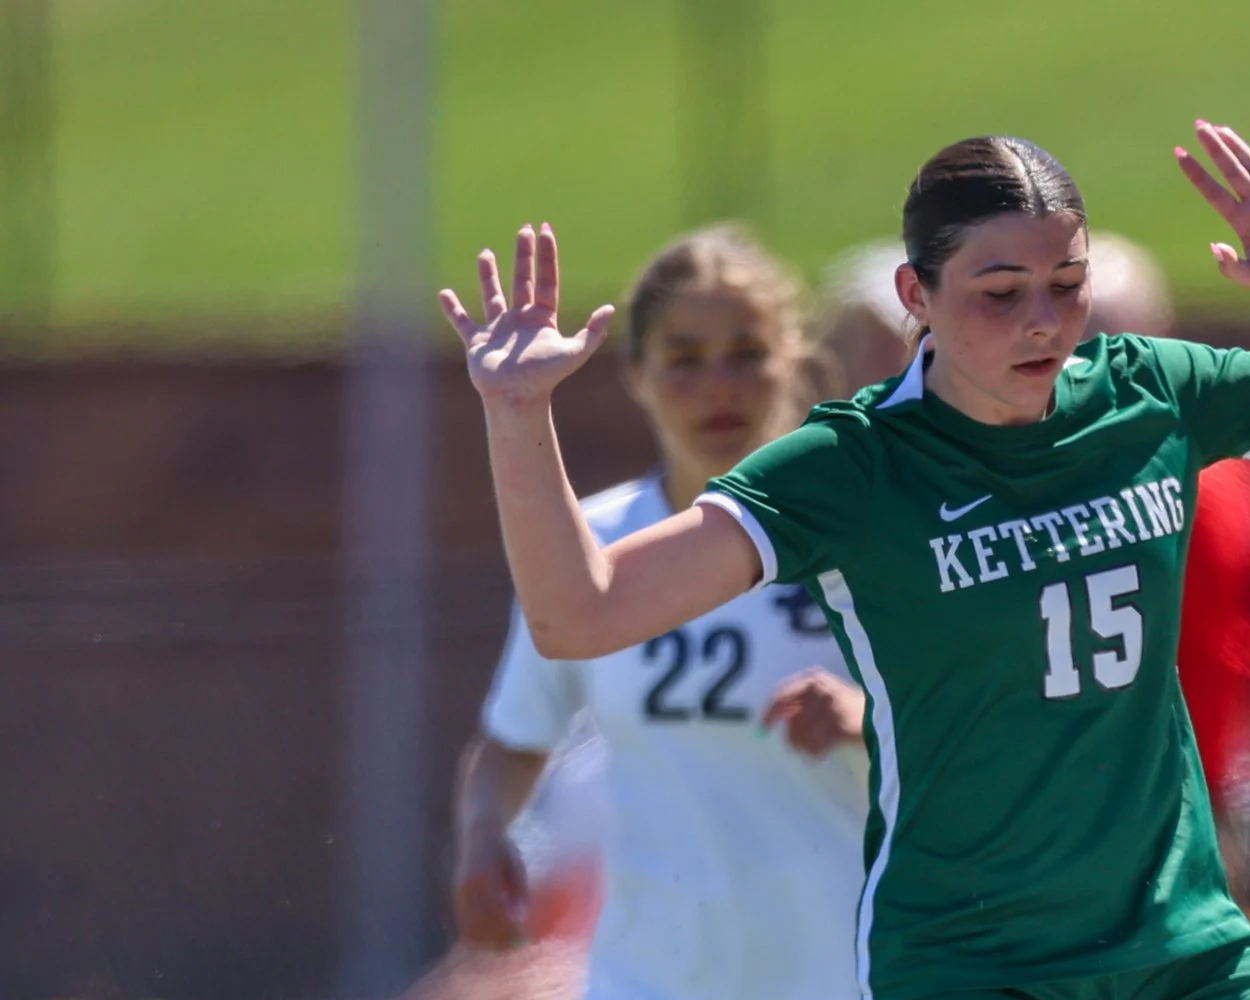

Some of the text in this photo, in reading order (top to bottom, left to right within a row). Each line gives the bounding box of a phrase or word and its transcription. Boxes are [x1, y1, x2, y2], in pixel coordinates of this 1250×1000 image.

[929, 477, 1185, 592] KETTERING
[641, 624, 748, 723] 22
[1039, 563, 1145, 699] 15
